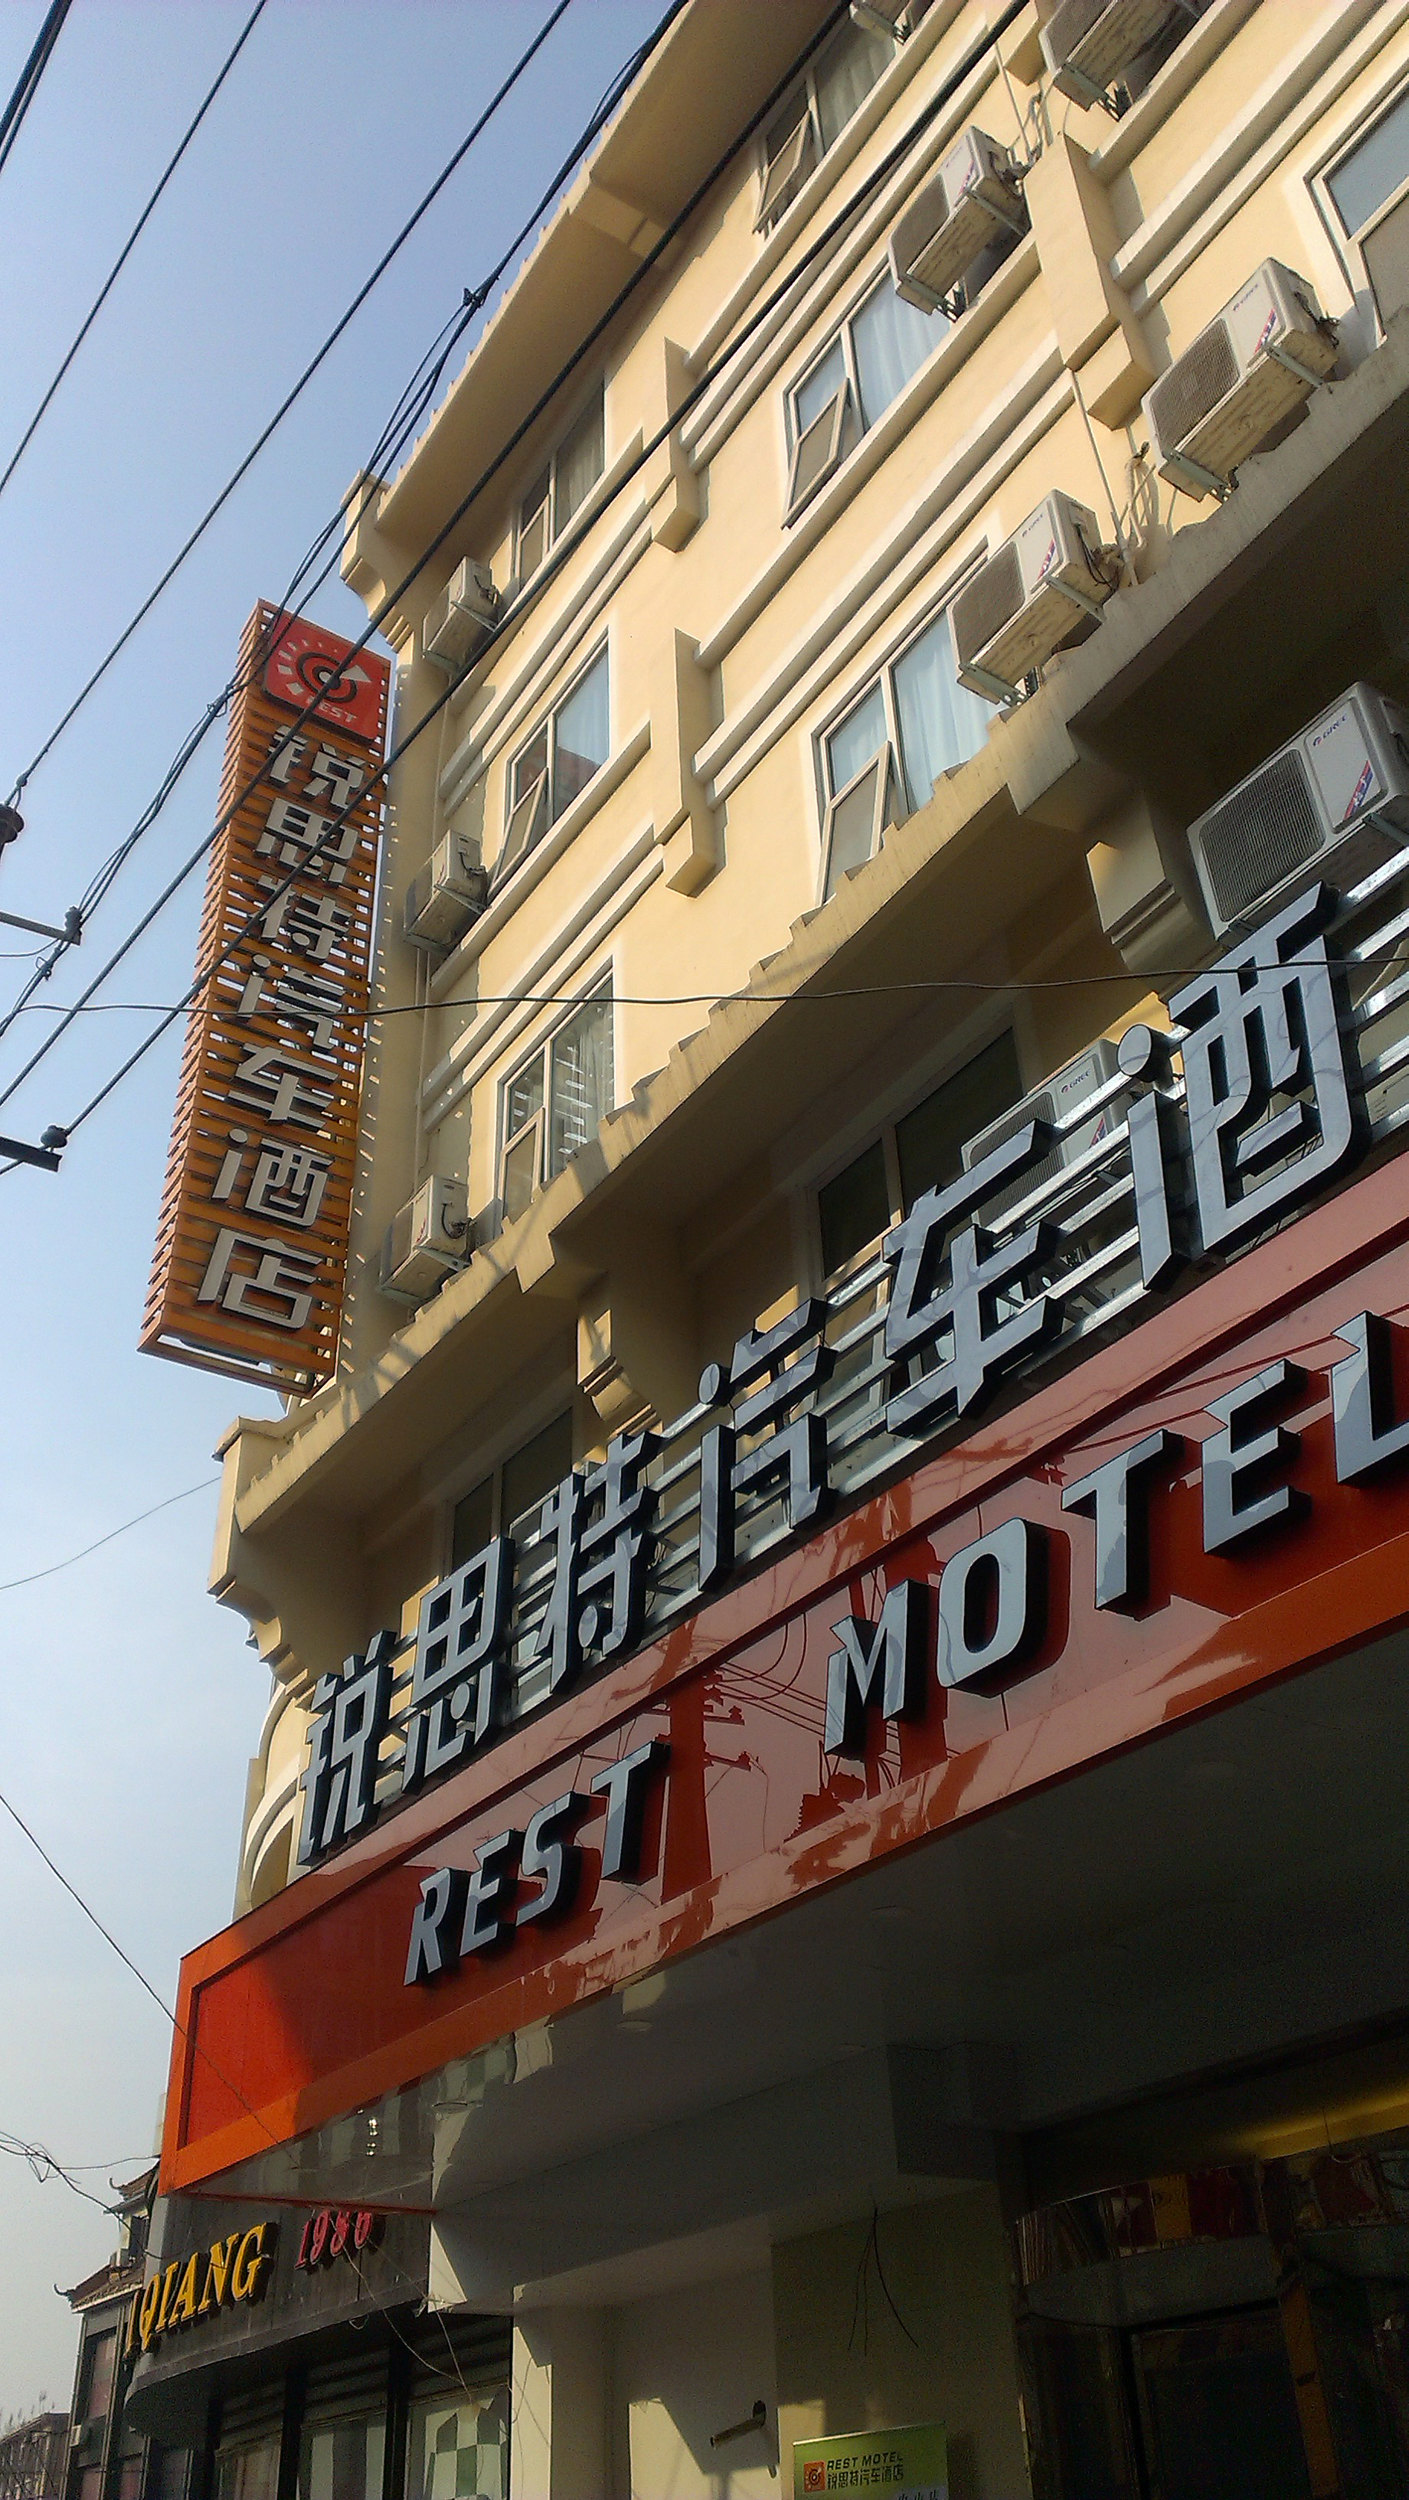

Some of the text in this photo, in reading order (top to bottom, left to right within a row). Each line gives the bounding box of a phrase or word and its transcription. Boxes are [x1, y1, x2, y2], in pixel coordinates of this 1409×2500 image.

[197, 725, 366, 1330] 锐思特汽车酒店
[297, 879, 1353, 1865] 锐思特汽车酒
[403, 1311, 1409, 1987] REST MOTEL
[826, 2456, 859, 2472] REST
